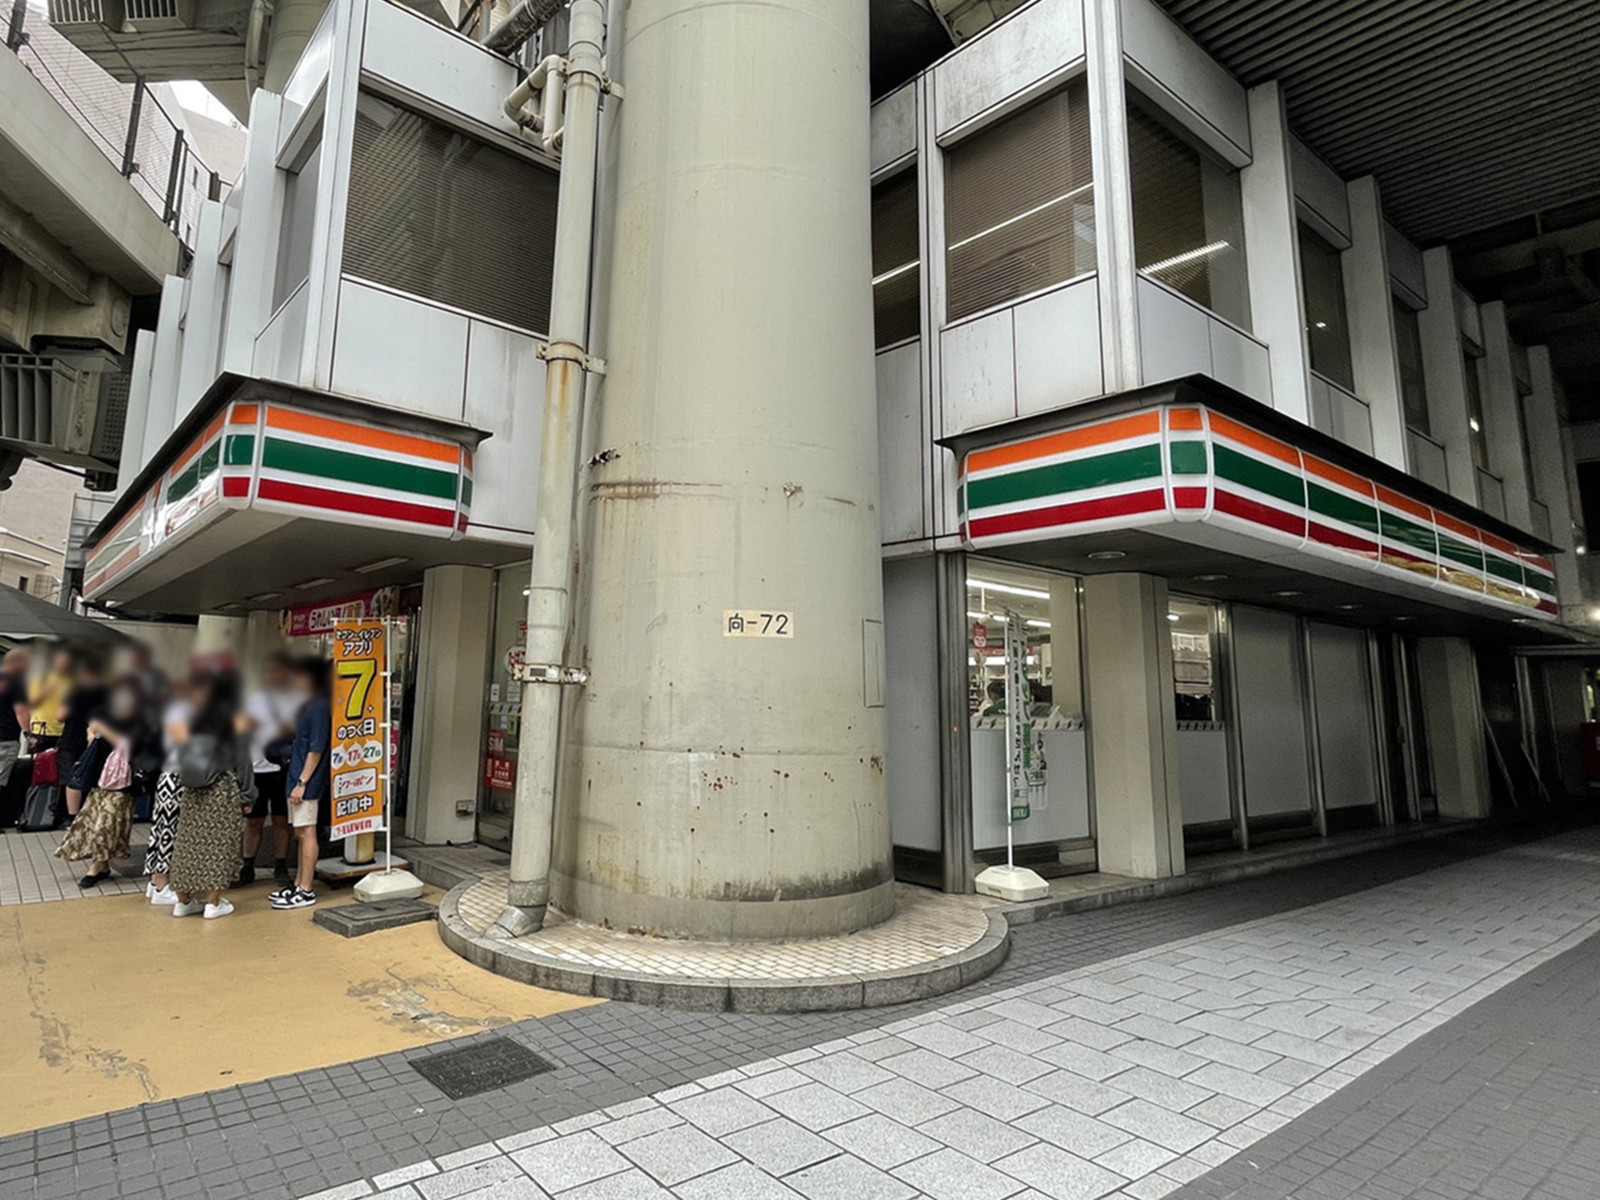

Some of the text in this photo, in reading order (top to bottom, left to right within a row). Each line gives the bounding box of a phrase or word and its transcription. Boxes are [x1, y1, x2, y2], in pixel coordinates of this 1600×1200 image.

[728, 613, 788, 635] 向-72
[343, 640, 373, 656] アプリ
[337, 659, 376, 719] 7
[337, 718, 375, 739] のつく日
[336, 795, 373, 818] 配信中
